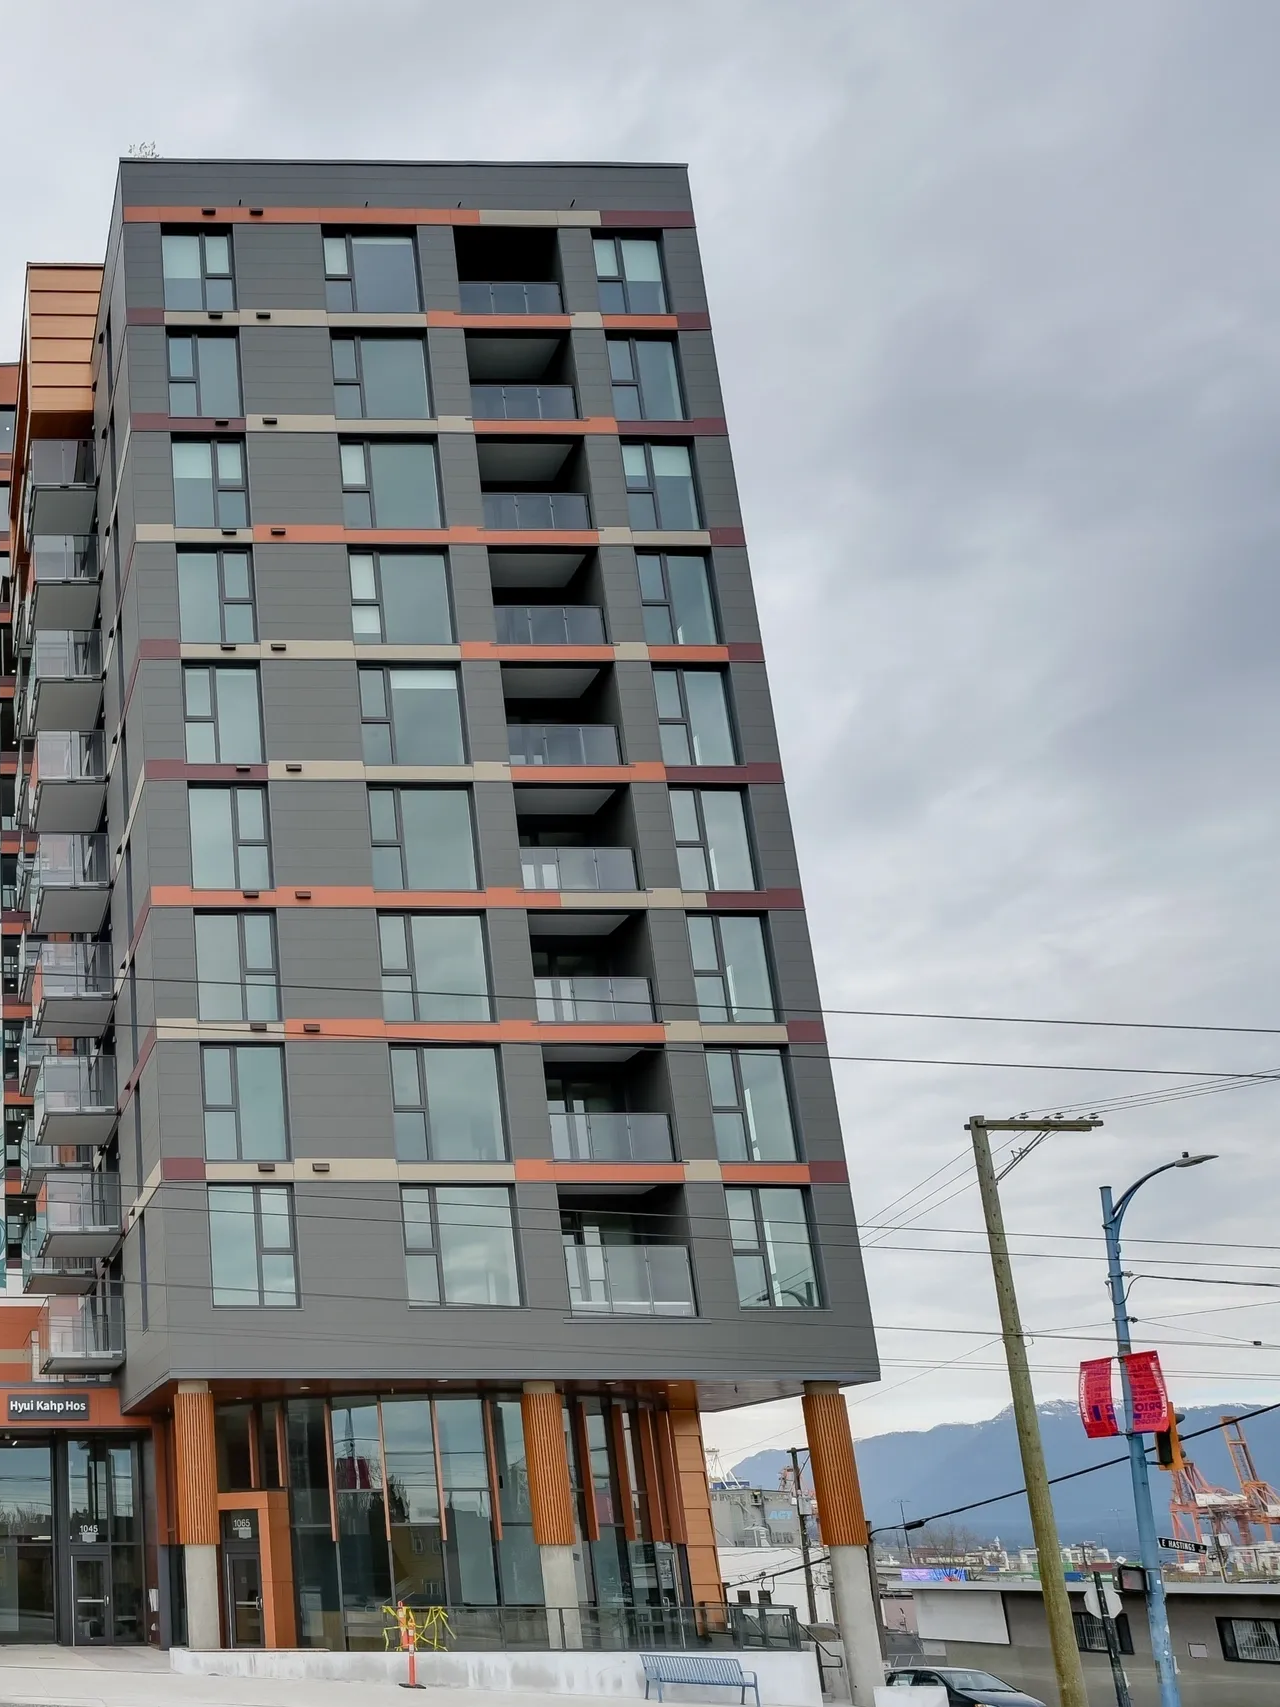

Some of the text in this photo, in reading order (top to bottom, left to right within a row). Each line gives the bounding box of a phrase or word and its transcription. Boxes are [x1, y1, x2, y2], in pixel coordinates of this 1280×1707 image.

[10, 1400, 86, 1413] Hyui Kahp Hos
[233, 1518, 251, 1527] 1065
[80, 1524, 98, 1533] 1045
[1161, 1539, 1166, 1547] E
[1168, 1540, 1196, 1552] HASTINGS
